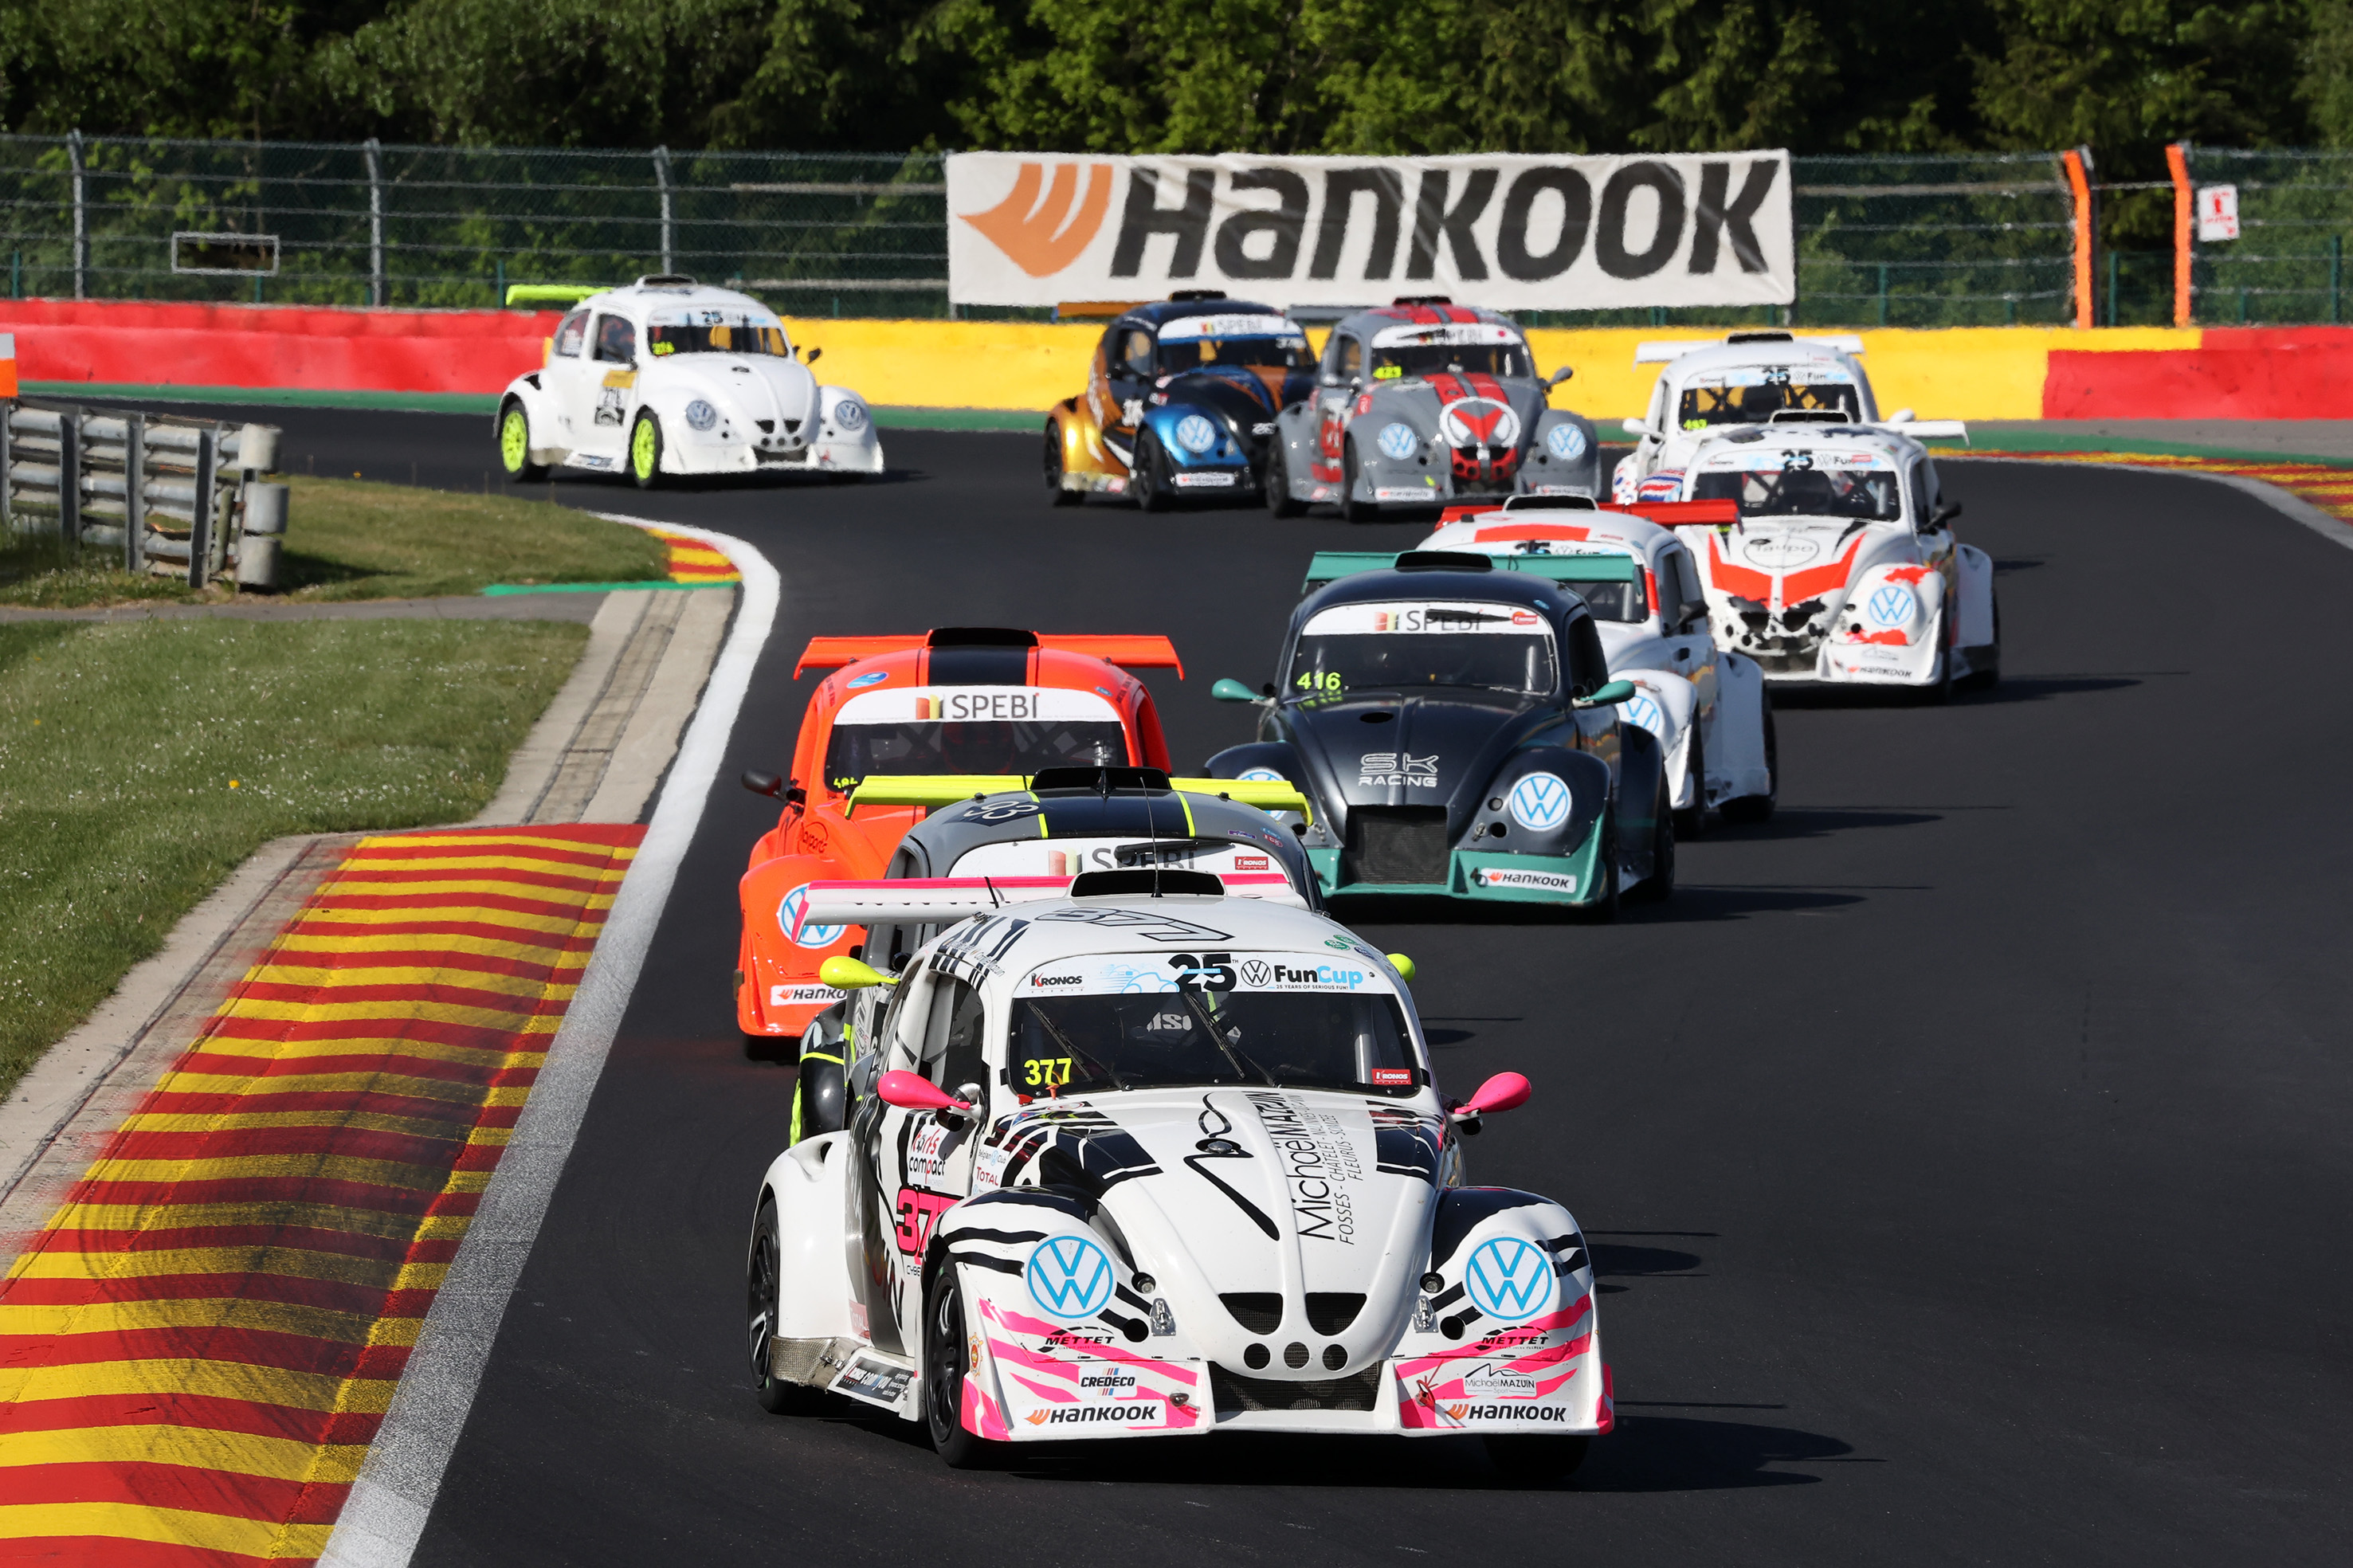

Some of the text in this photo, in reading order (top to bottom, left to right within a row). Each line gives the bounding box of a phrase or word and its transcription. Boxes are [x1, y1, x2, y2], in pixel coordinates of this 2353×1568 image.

[1780, 449, 1814, 471] 25
[1296, 672, 1342, 691] 416
[951, 692, 1041, 719] SPEBI
[1361, 752, 1439, 774] SK
[1358, 774, 1438, 787] RACING
[1033, 907, 1236, 943] 377
[1030, 972, 1083, 987] KRONOS
[1167, 954, 1237, 993] 25
[1274, 965, 1363, 990] FunCup
[1024, 1057, 1073, 1086] 377
[908, 1153, 947, 1185] compact
[1335, 1140, 1363, 1181] FLEURUS
[1334, 1193, 1355, 1245] FOSSES
[1045, 1336, 1115, 1346] METTET
[1481, 1336, 1550, 1345] METTET
[1080, 1377, 1135, 1387] CREDECO
